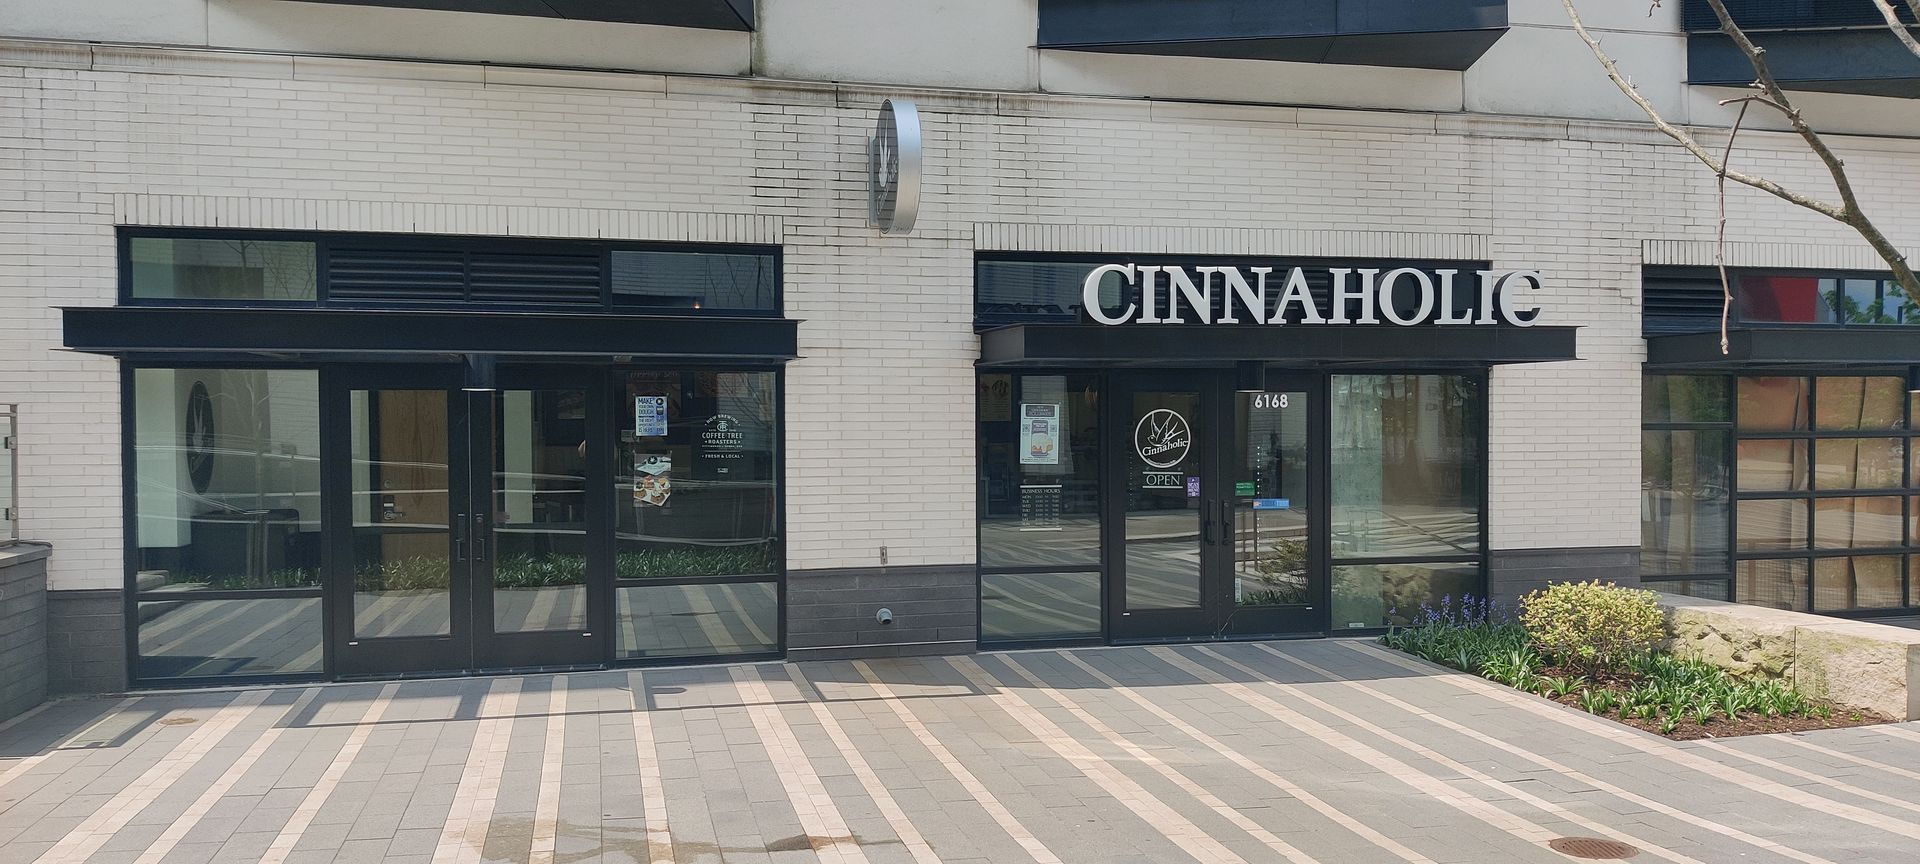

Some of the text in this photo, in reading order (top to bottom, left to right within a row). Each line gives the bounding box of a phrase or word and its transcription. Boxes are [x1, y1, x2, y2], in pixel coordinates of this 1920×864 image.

[1082, 262, 1544, 327] CINNAHOLIC
[1254, 394, 1289, 408] 6168
[706, 414, 739, 424] NOW BREWING
[1142, 438, 1188, 456] Cinnaholic
[1146, 475, 1180, 486] OPEN
